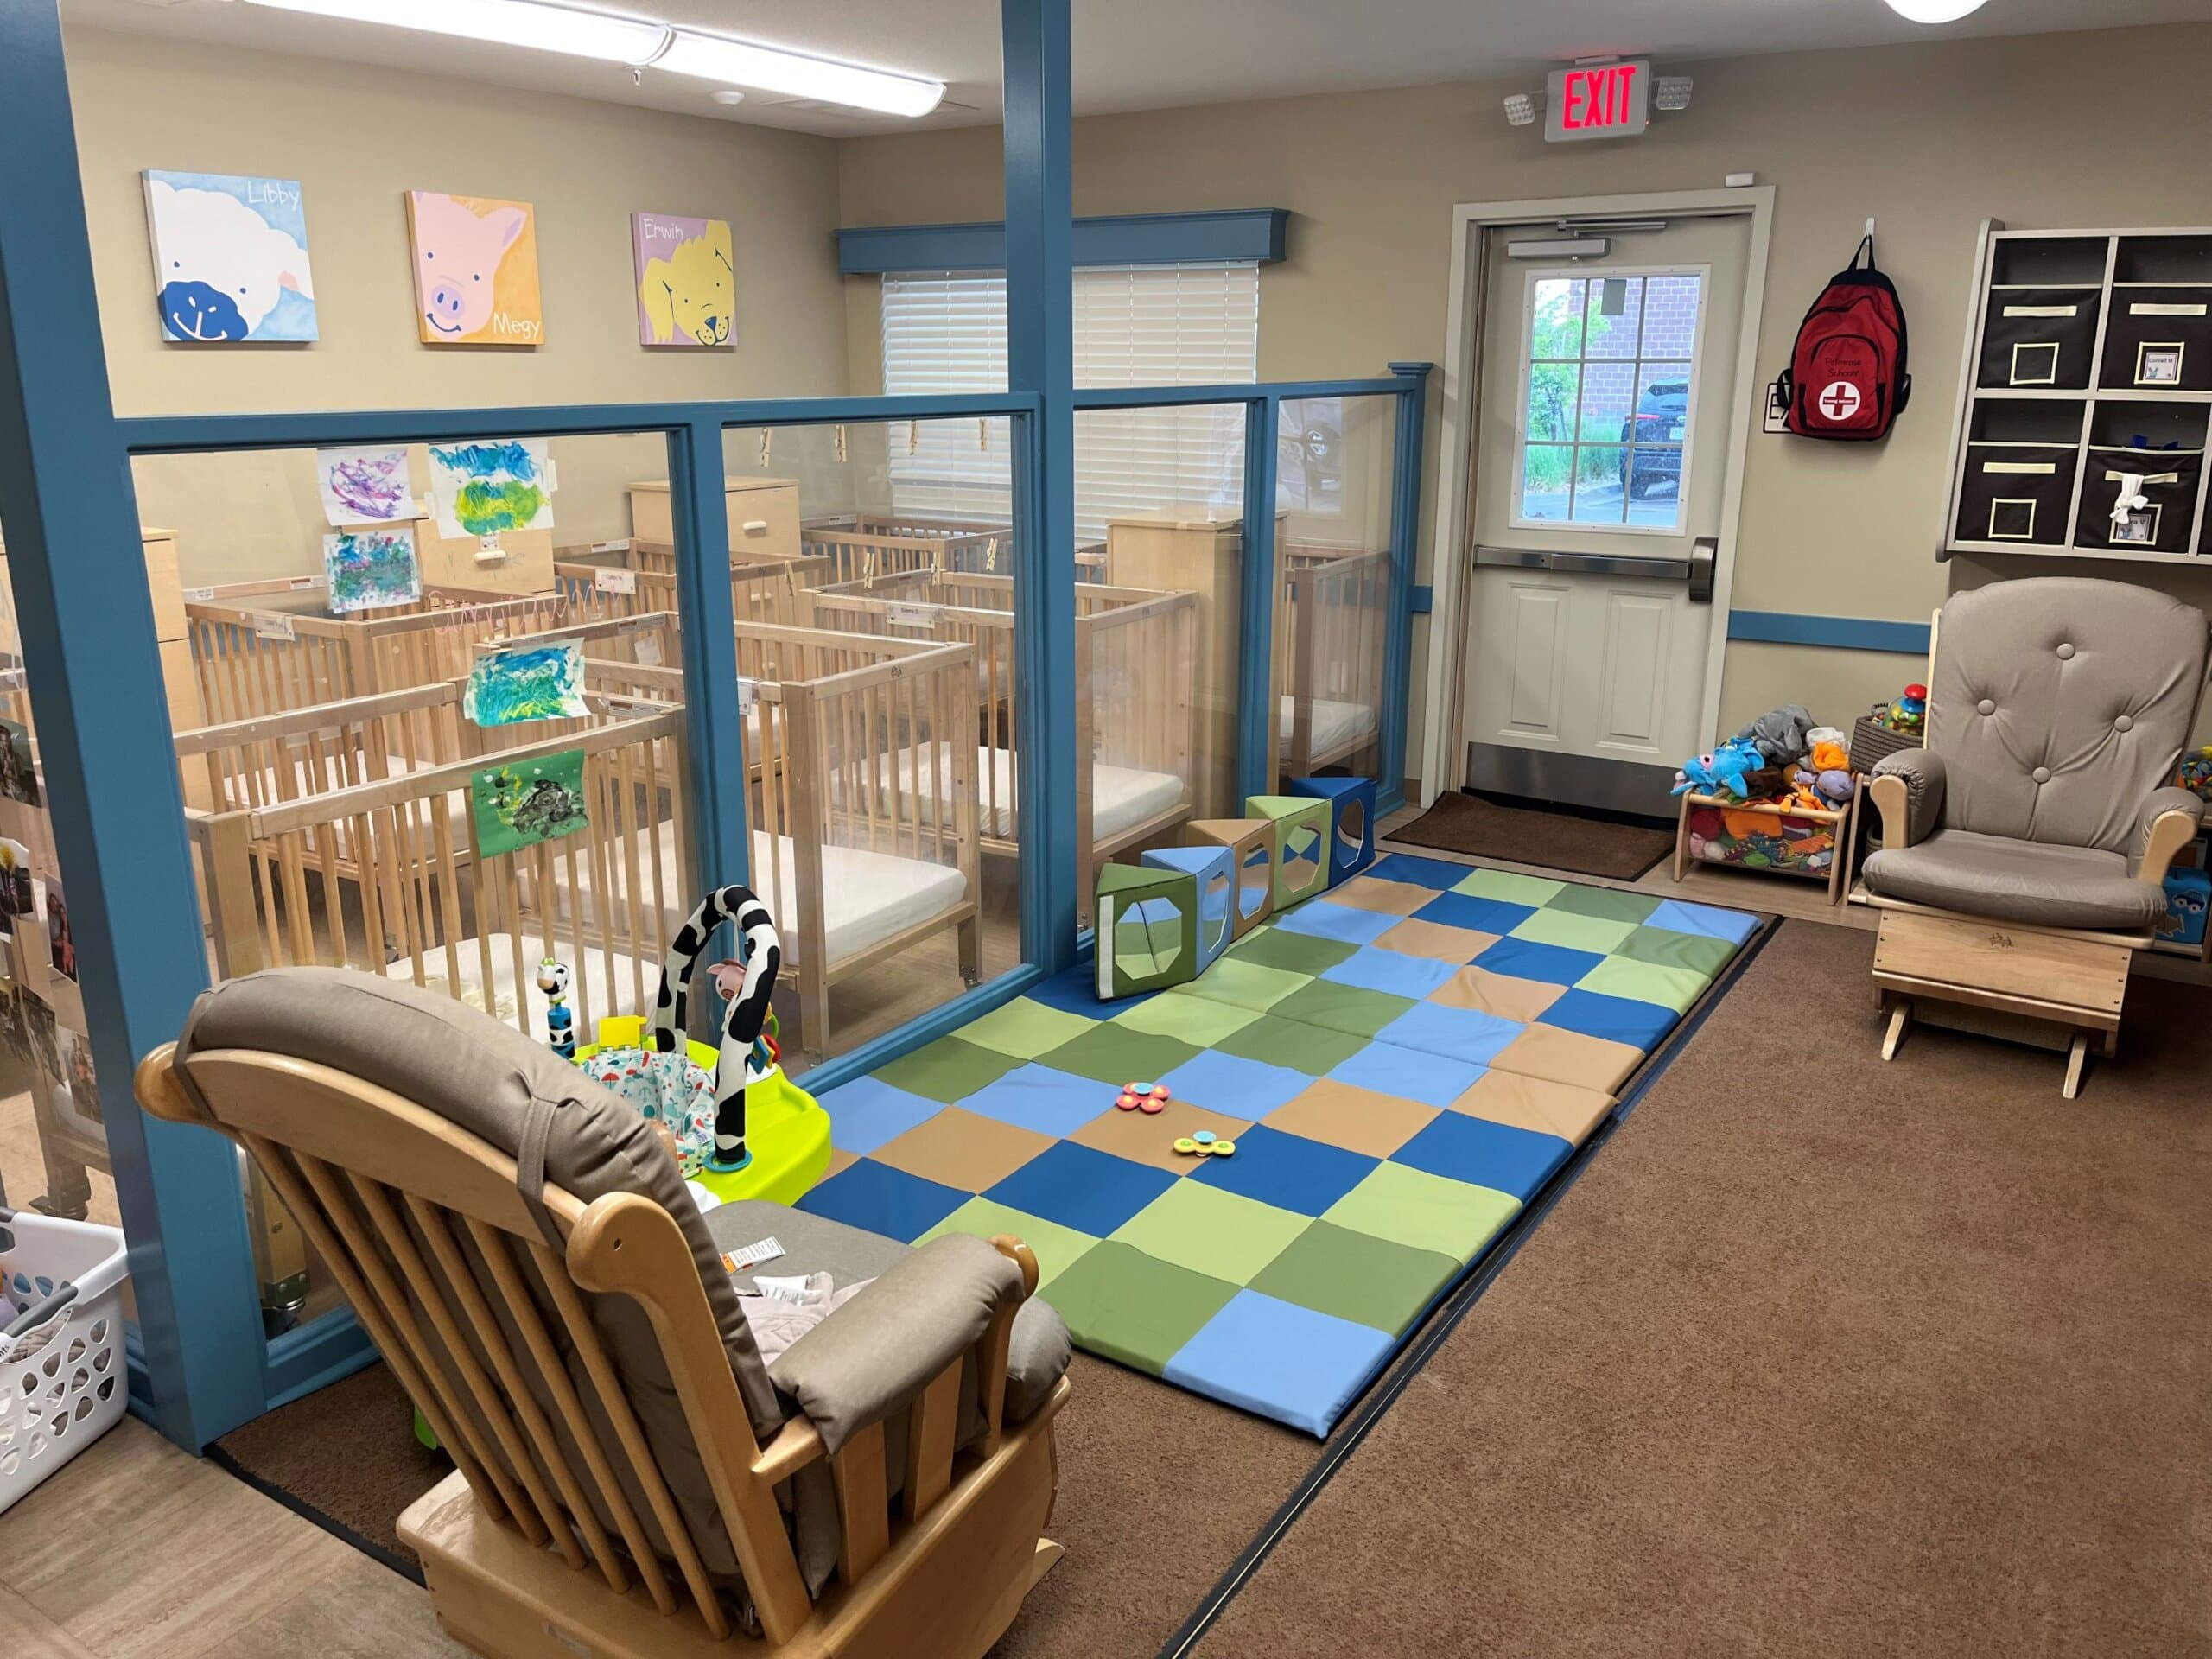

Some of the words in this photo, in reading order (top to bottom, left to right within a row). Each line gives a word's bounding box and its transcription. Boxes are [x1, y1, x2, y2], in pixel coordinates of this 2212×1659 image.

[1562, 65, 1637, 130] EXIT
[247, 179, 300, 211] Libby
[644, 218, 684, 241] Erwin
[493, 310, 540, 340] Megy
